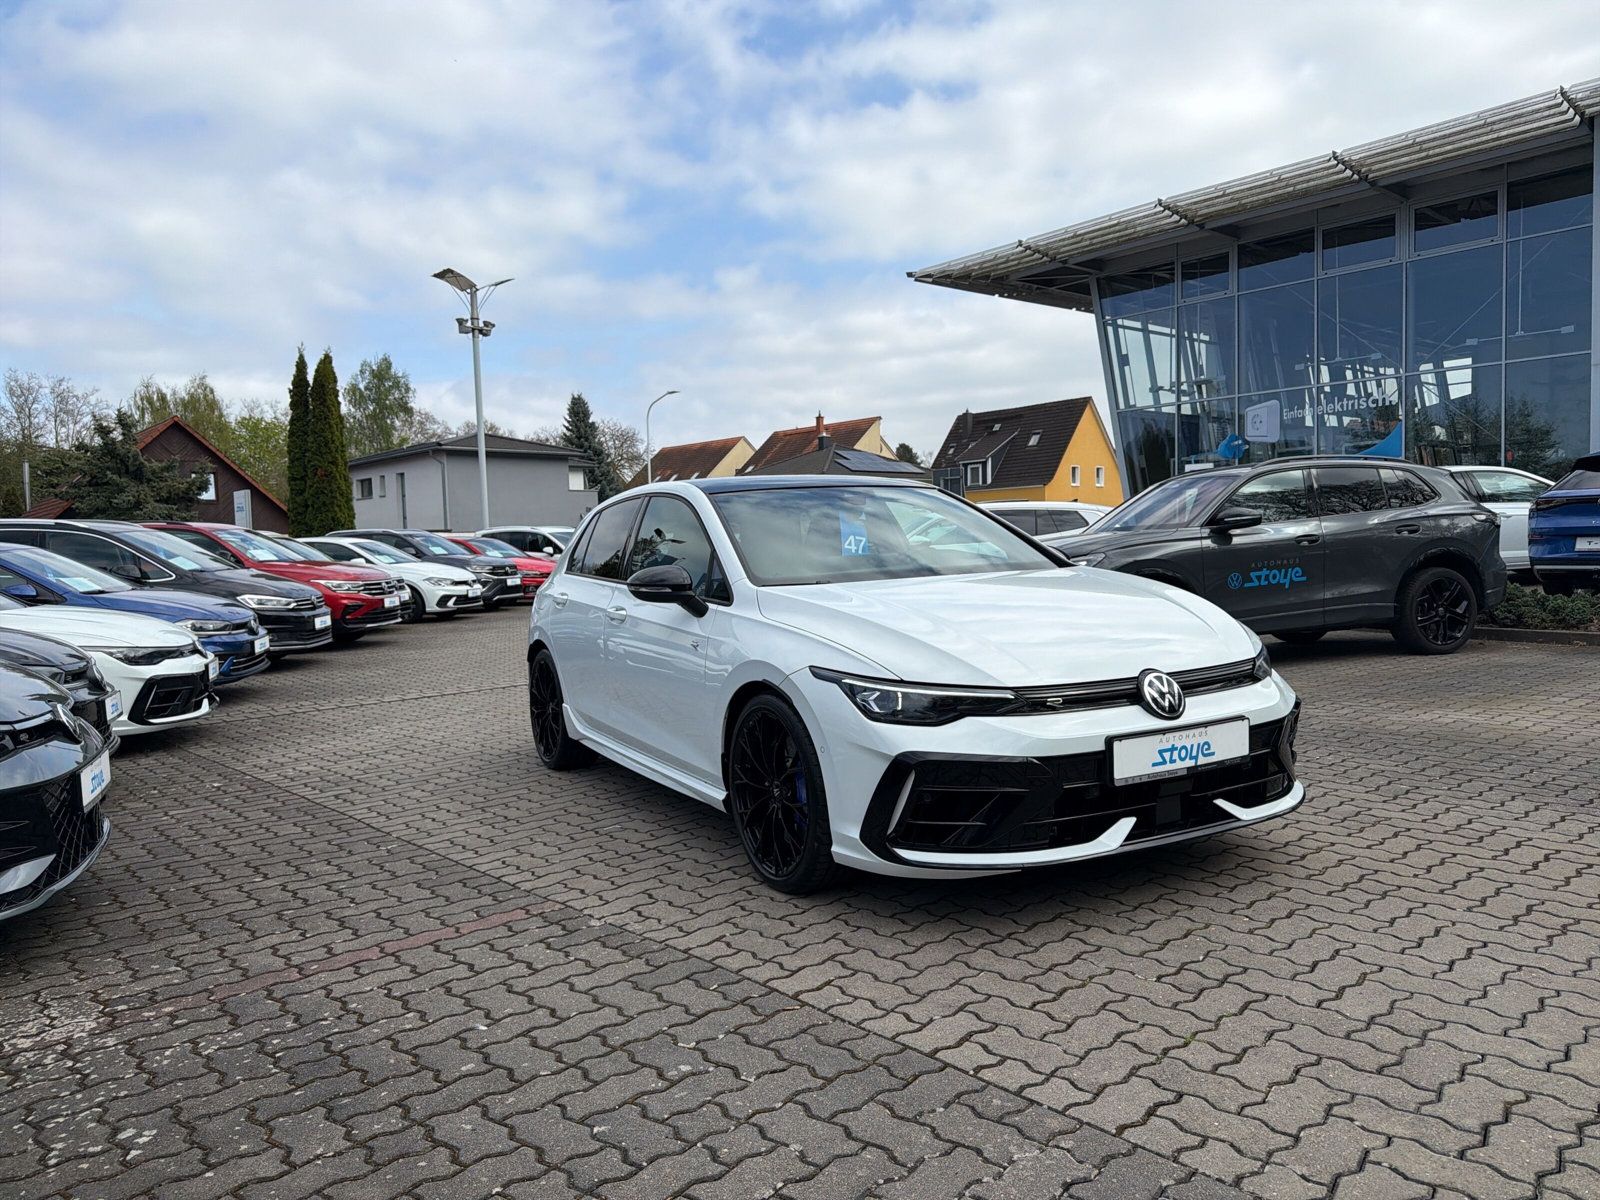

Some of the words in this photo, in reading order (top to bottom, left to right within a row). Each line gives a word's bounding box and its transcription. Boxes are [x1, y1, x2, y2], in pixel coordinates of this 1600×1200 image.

[844, 535, 866, 554] 47
[1251, 558, 1300, 568] AUTOHAUS
[1159, 730, 1208, 744] AUTOHAUS
